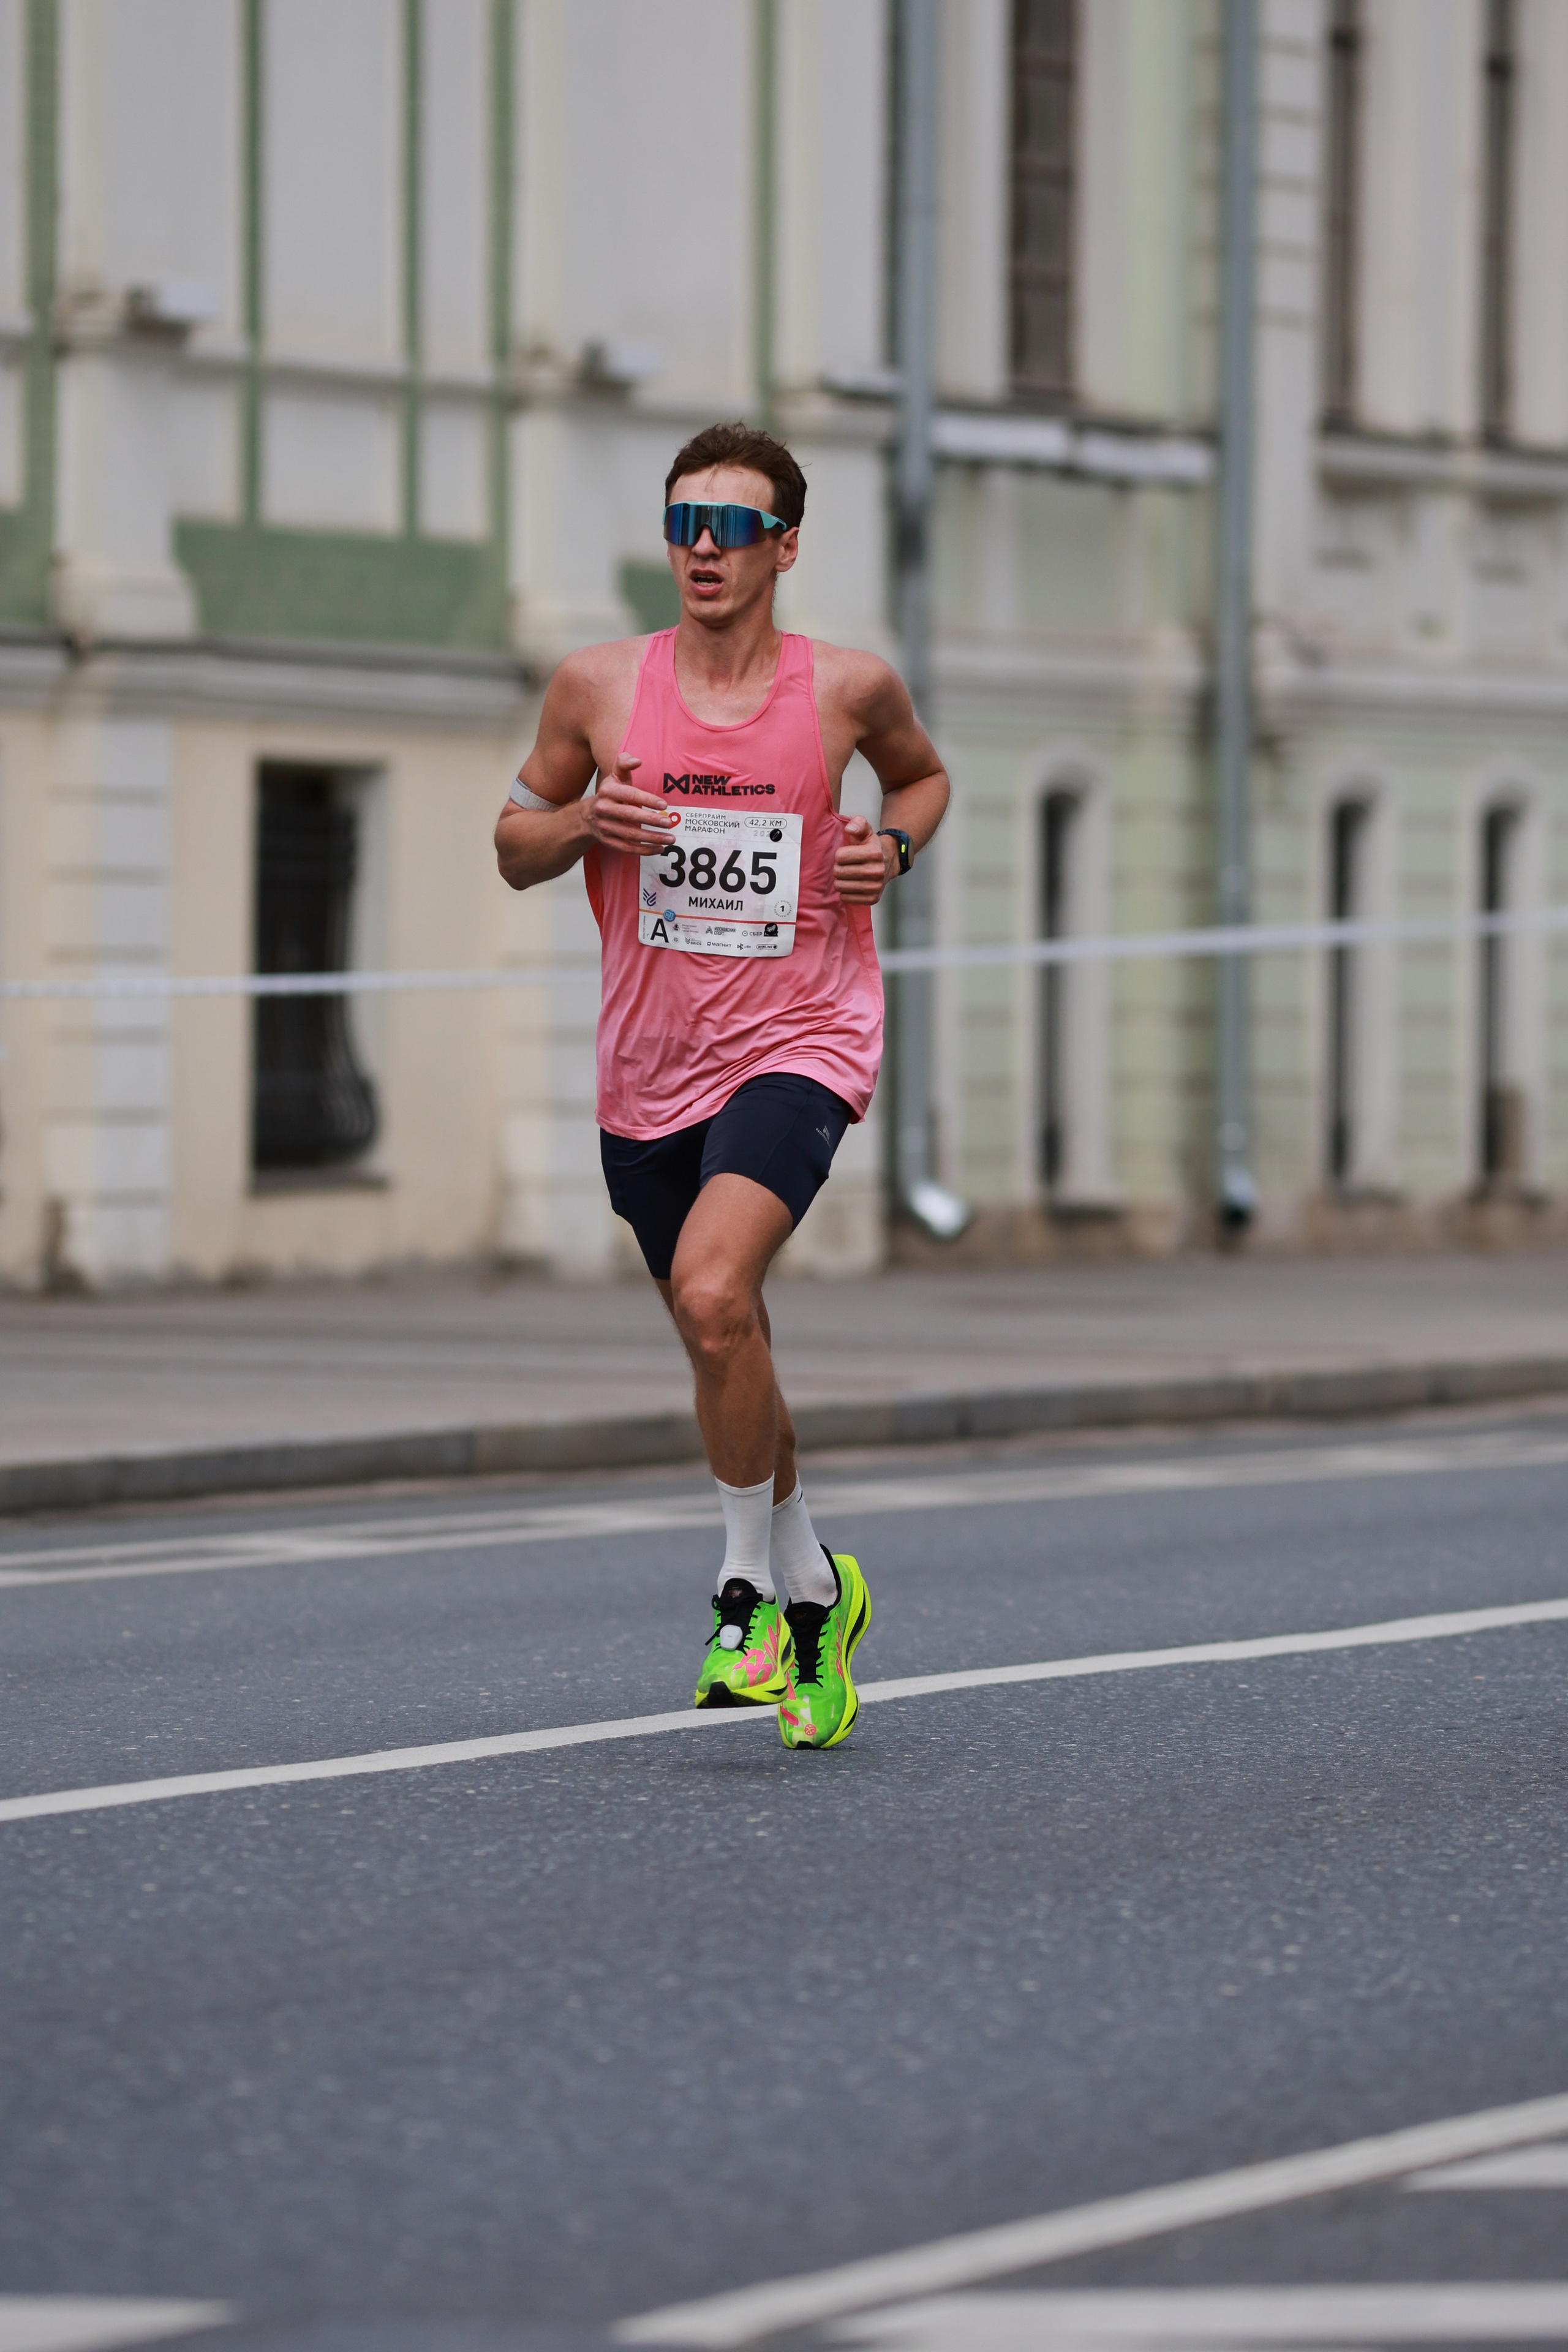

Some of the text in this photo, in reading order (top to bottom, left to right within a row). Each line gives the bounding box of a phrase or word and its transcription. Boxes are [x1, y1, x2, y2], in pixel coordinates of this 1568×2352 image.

[692, 774, 731, 785] NEW
[692, 784, 775, 796] ATHLETICS
[685, 818, 740, 829] МОСКОВСКИЙ
[684, 825, 725, 834] МАРАФОН
[658, 845, 777, 895] 3865
[688, 896, 744, 911] МИХАИЛ
